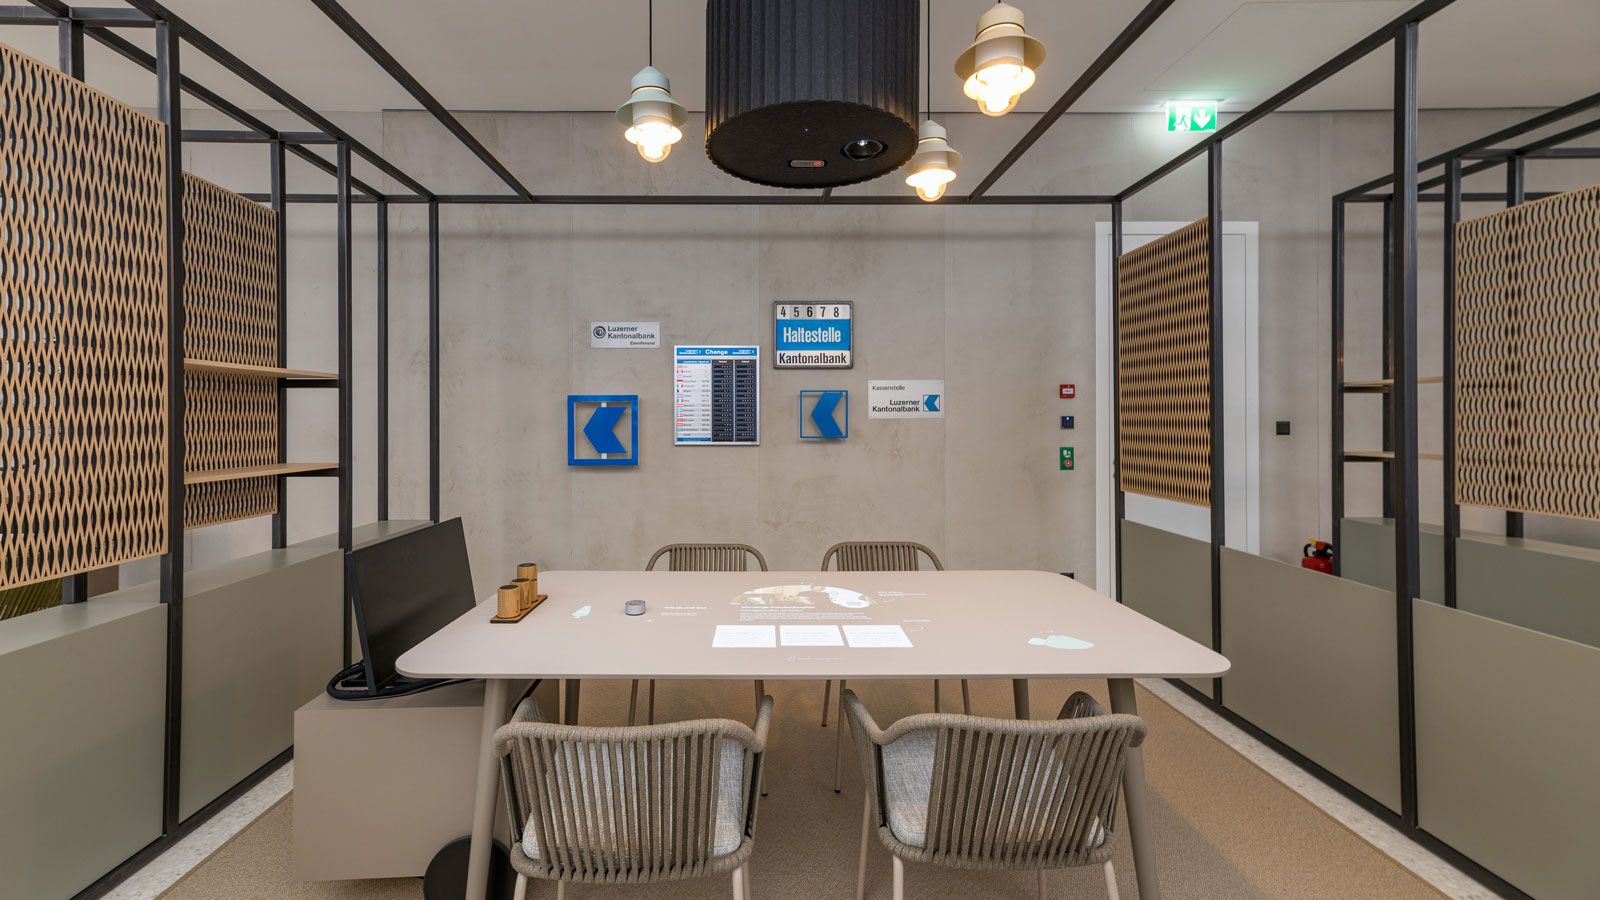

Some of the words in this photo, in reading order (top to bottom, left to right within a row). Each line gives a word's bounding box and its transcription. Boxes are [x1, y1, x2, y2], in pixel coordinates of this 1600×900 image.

[780, 306, 787, 318] 4
[793, 306, 800, 318] 5
[806, 306, 813, 318] 6
[820, 306, 826, 318] 7
[833, 306, 840, 318] 8
[783, 327, 842, 343] Haltestelle
[779, 352, 847, 364] Kantonalbank
